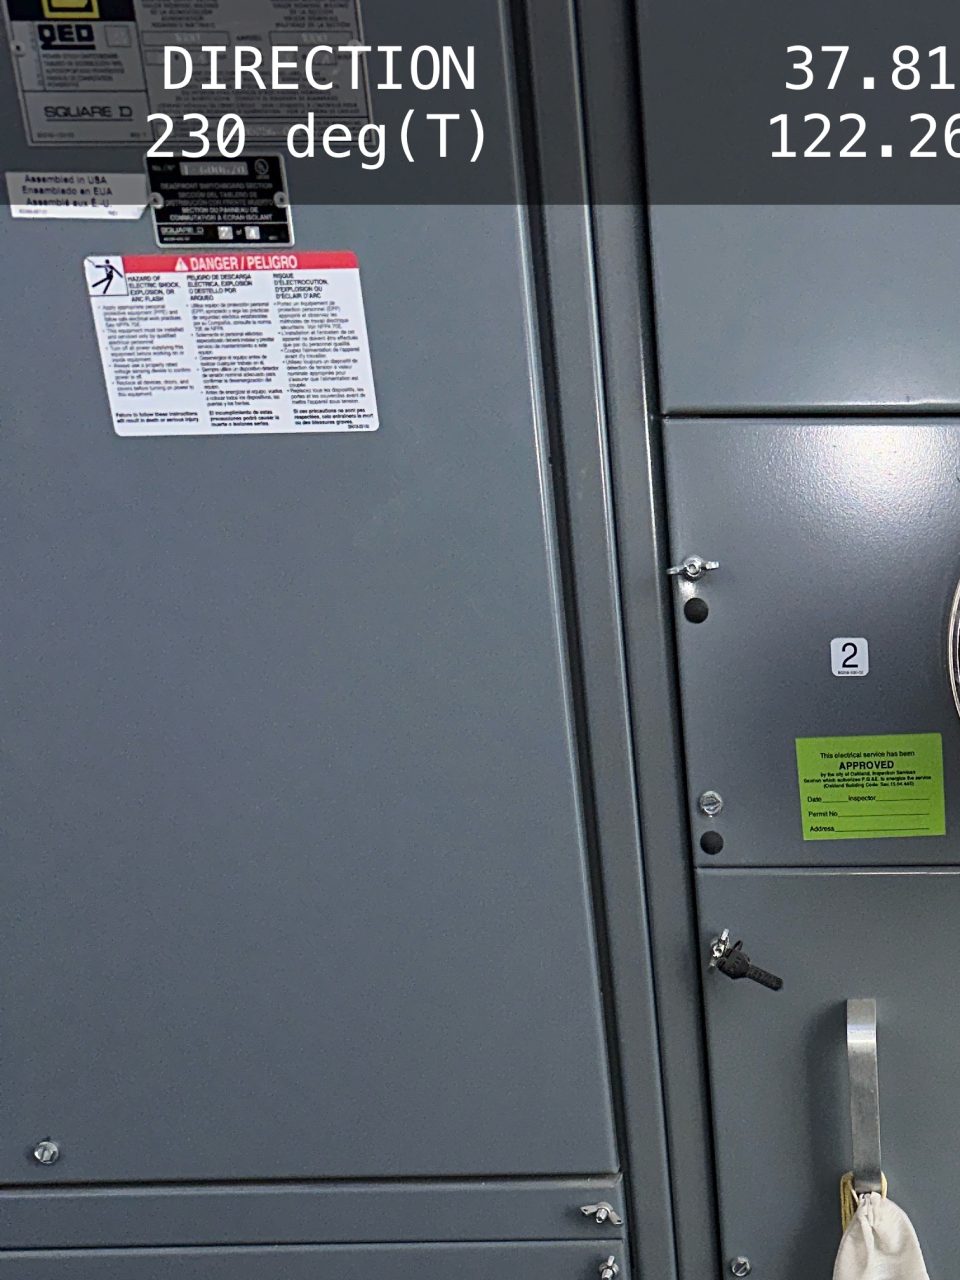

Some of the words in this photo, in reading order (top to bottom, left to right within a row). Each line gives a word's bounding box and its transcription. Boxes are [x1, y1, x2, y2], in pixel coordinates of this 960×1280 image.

[44, 106, 113, 118] SQUARE
[119, 106, 133, 118] D
[24, 174, 75, 184] Assembled
[87, 175, 107, 185] USA
[22, 185, 78, 196] Ensamblado
[93, 186, 113, 196] EUA
[190, 256, 239, 271] DANGER
[246, 255, 298, 270] PELIGRO
[841, 642, 858, 668] 2
[839, 760, 894, 770] APPROVED
